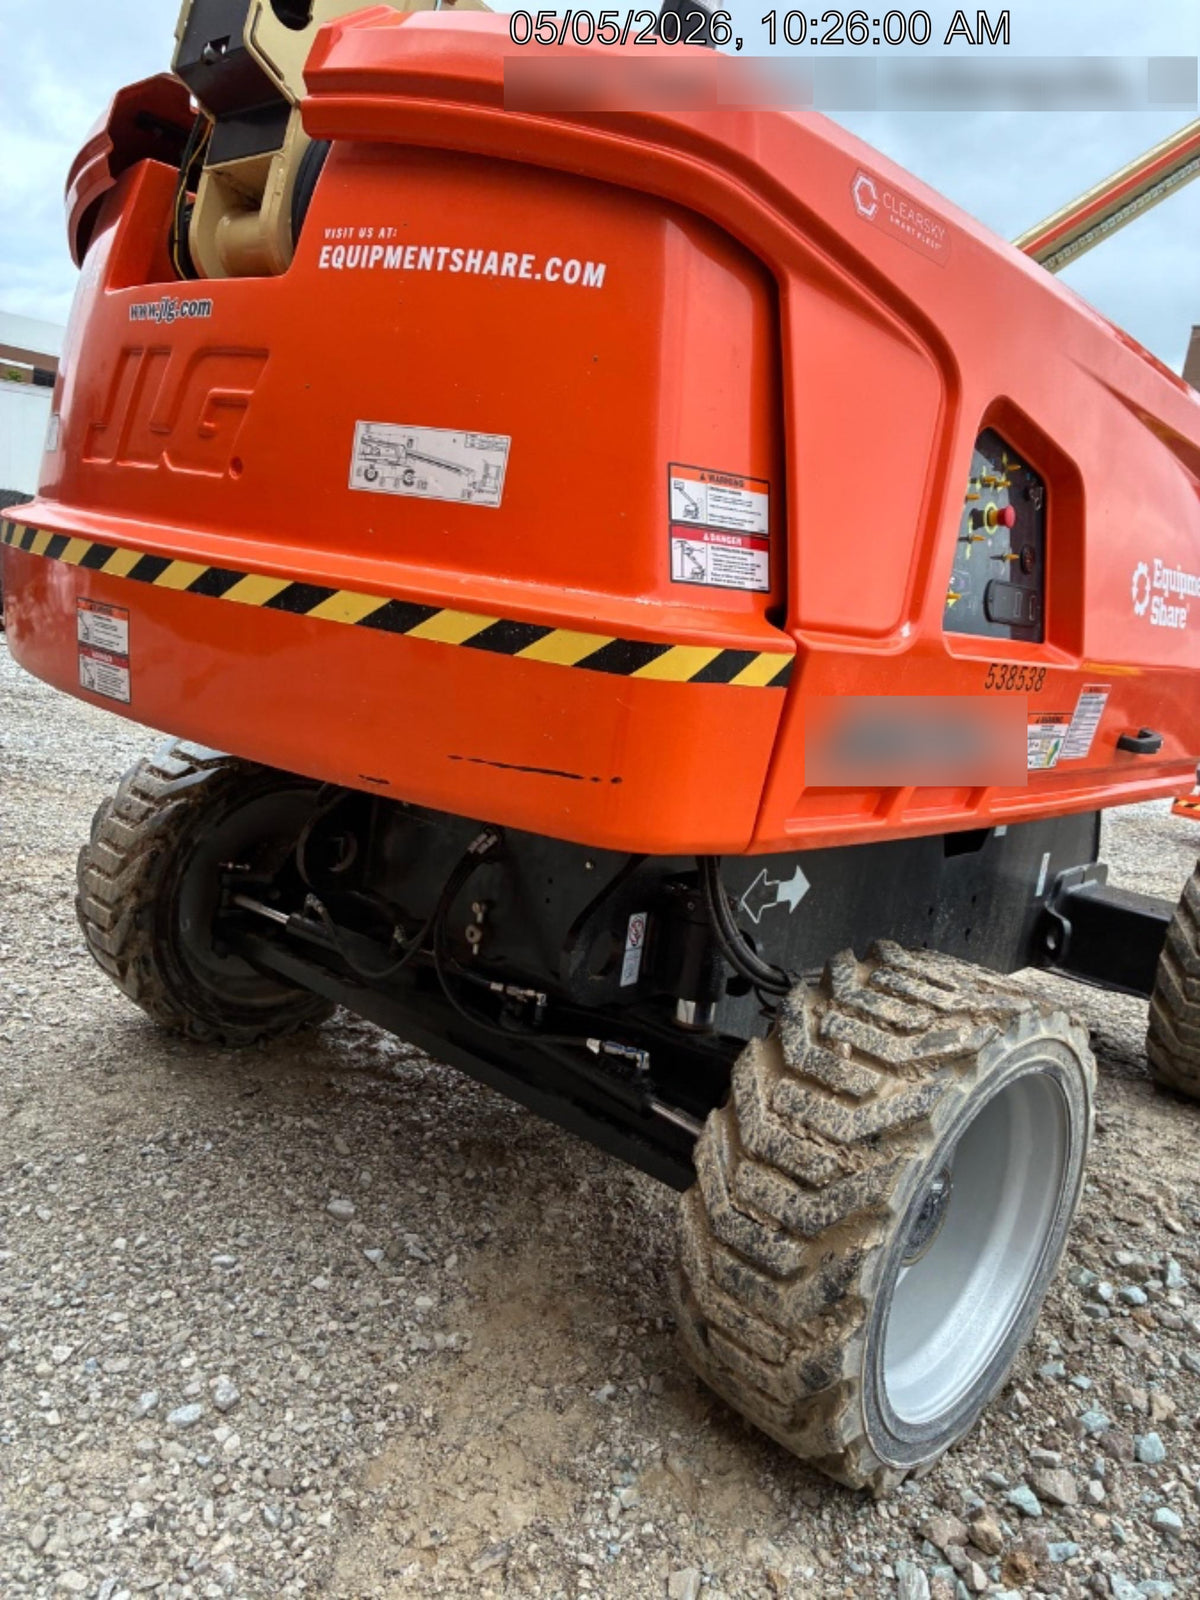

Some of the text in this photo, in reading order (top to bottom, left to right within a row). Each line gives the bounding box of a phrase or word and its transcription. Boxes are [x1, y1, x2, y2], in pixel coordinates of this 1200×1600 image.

[324, 226, 398, 240] VISIT US AT:
[883, 192, 944, 240] CLEARSKY
[318, 245, 606, 288] EQUIPMENTSHARE.COM
[129, 297, 213, 323] www.jlg.com
[82, 346, 270, 478] JLG
[1150, 595, 1187, 629] Share
[984, 663, 1047, 692] 538538
